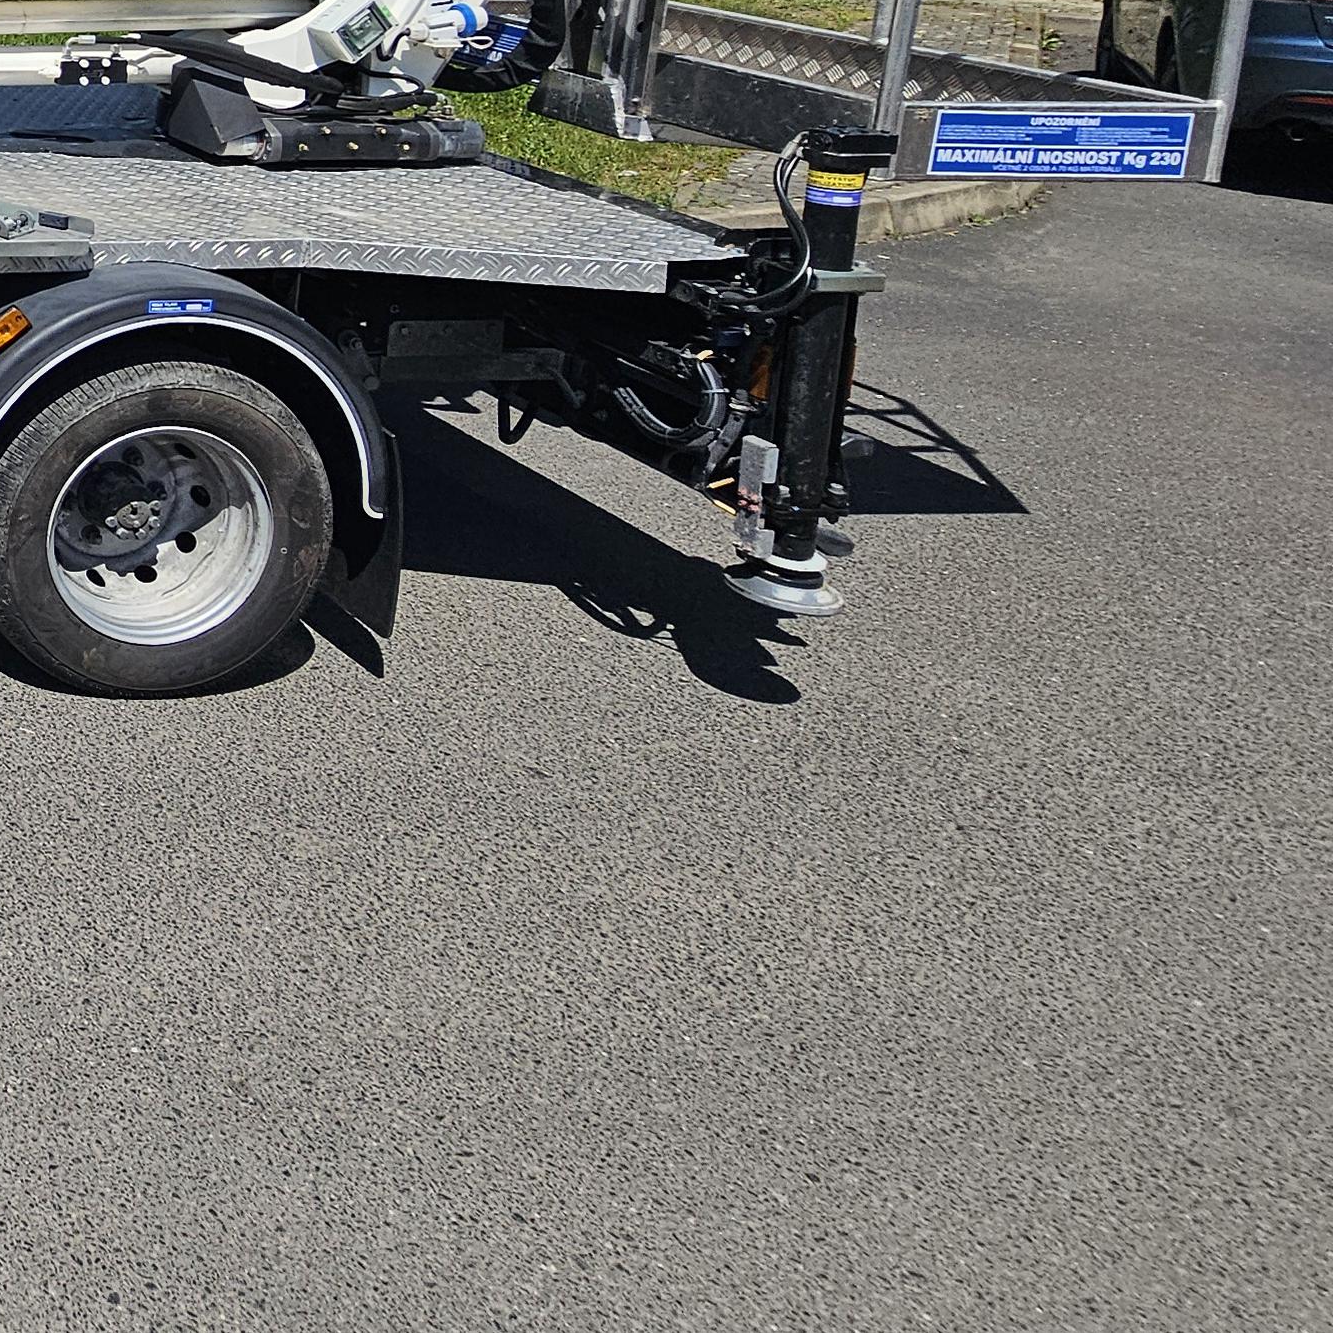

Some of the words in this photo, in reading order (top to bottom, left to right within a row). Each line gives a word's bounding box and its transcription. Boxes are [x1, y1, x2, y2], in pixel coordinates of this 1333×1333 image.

[936, 147, 1035, 164] MAXIMÁLNÍ
[1036, 150, 1122, 165] NOSNOST
[1122, 151, 1148, 169] Kg
[1149, 151, 1182, 166] 230
